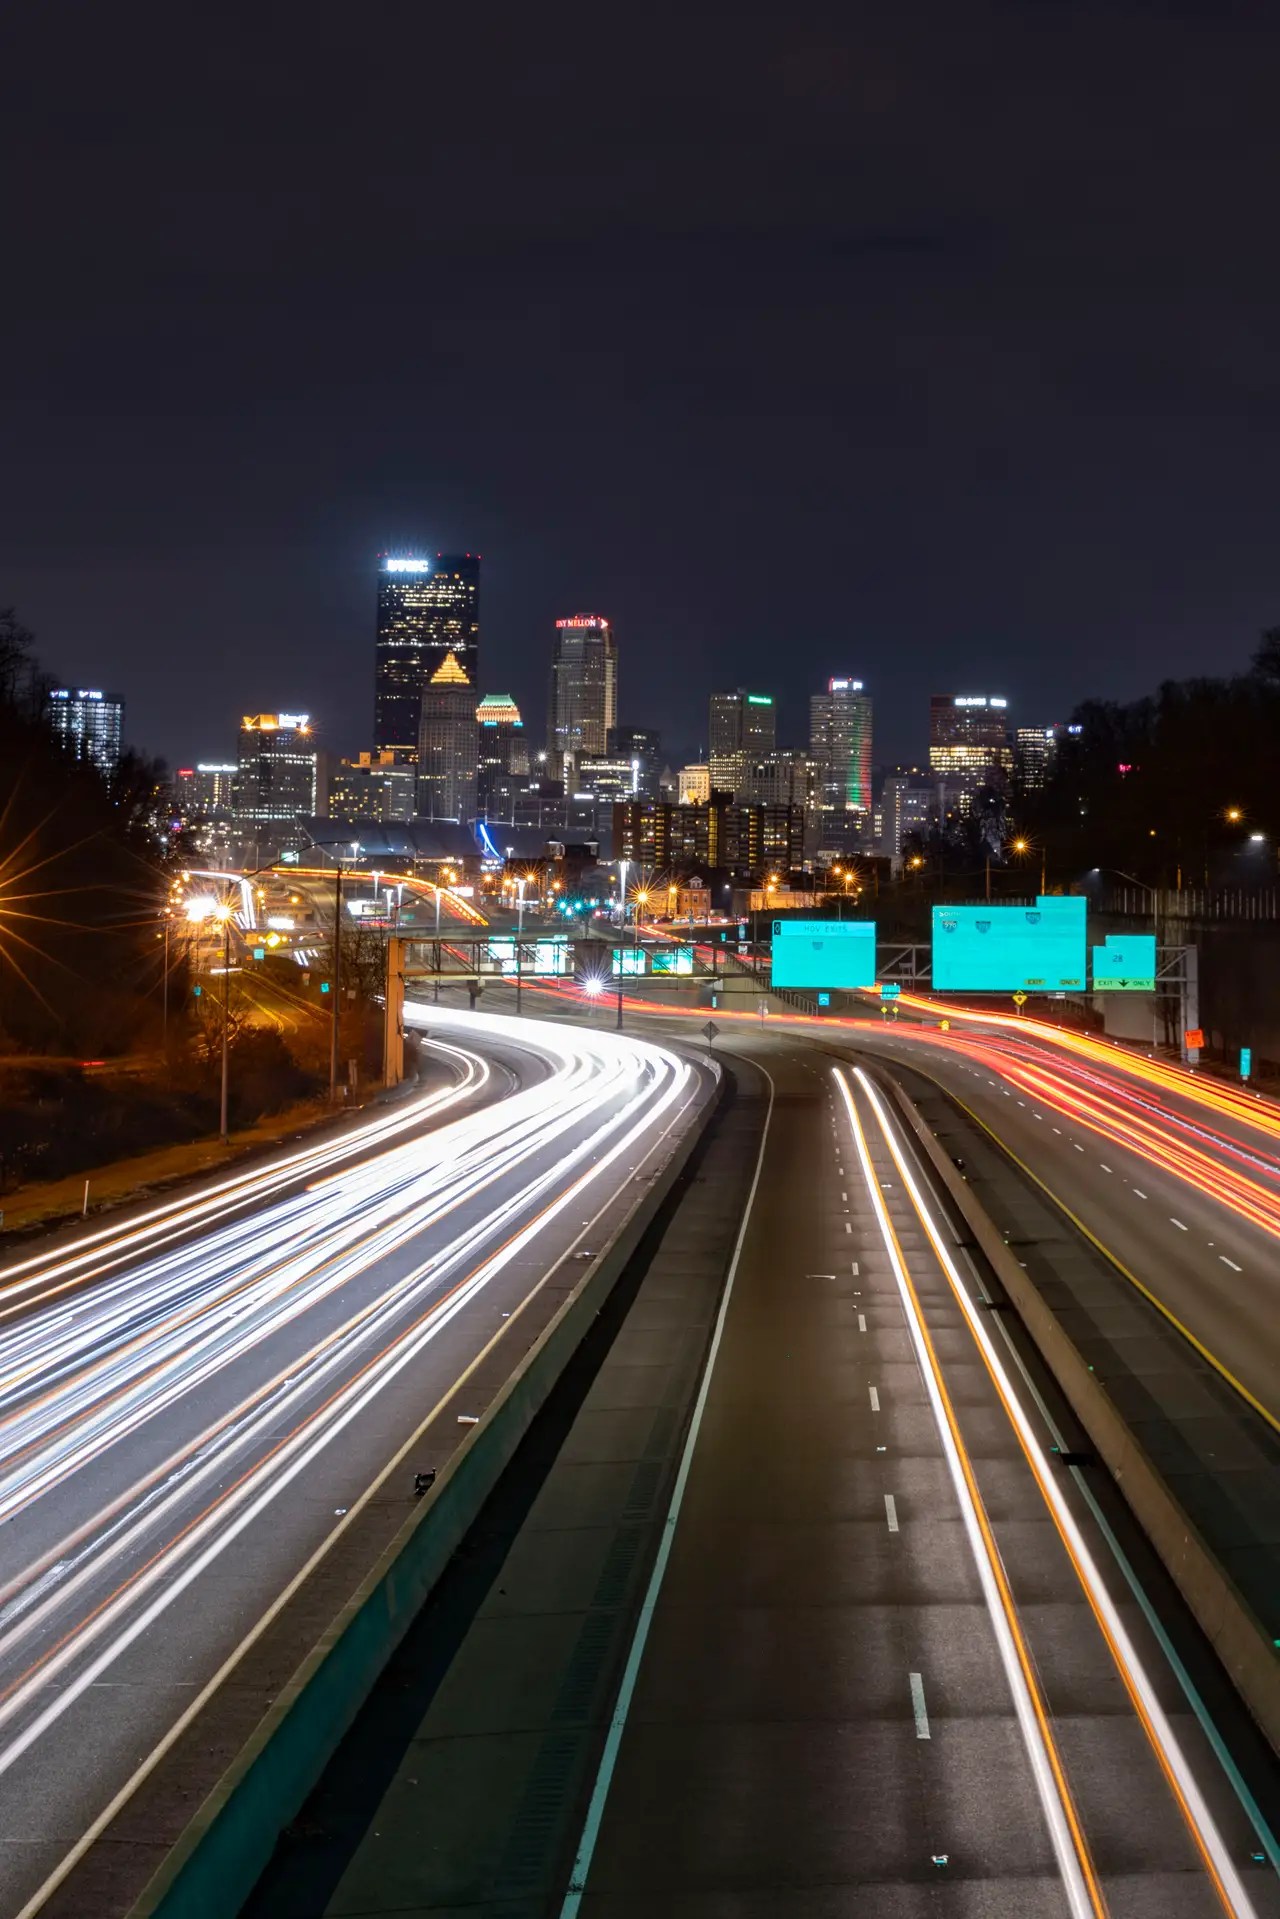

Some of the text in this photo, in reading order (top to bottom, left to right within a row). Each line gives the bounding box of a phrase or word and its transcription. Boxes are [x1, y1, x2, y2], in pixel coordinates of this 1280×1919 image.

[567, 619, 596, 628] MELLON
[825, 925, 848, 933] EXITS
[1112, 954, 1124, 963] 28
